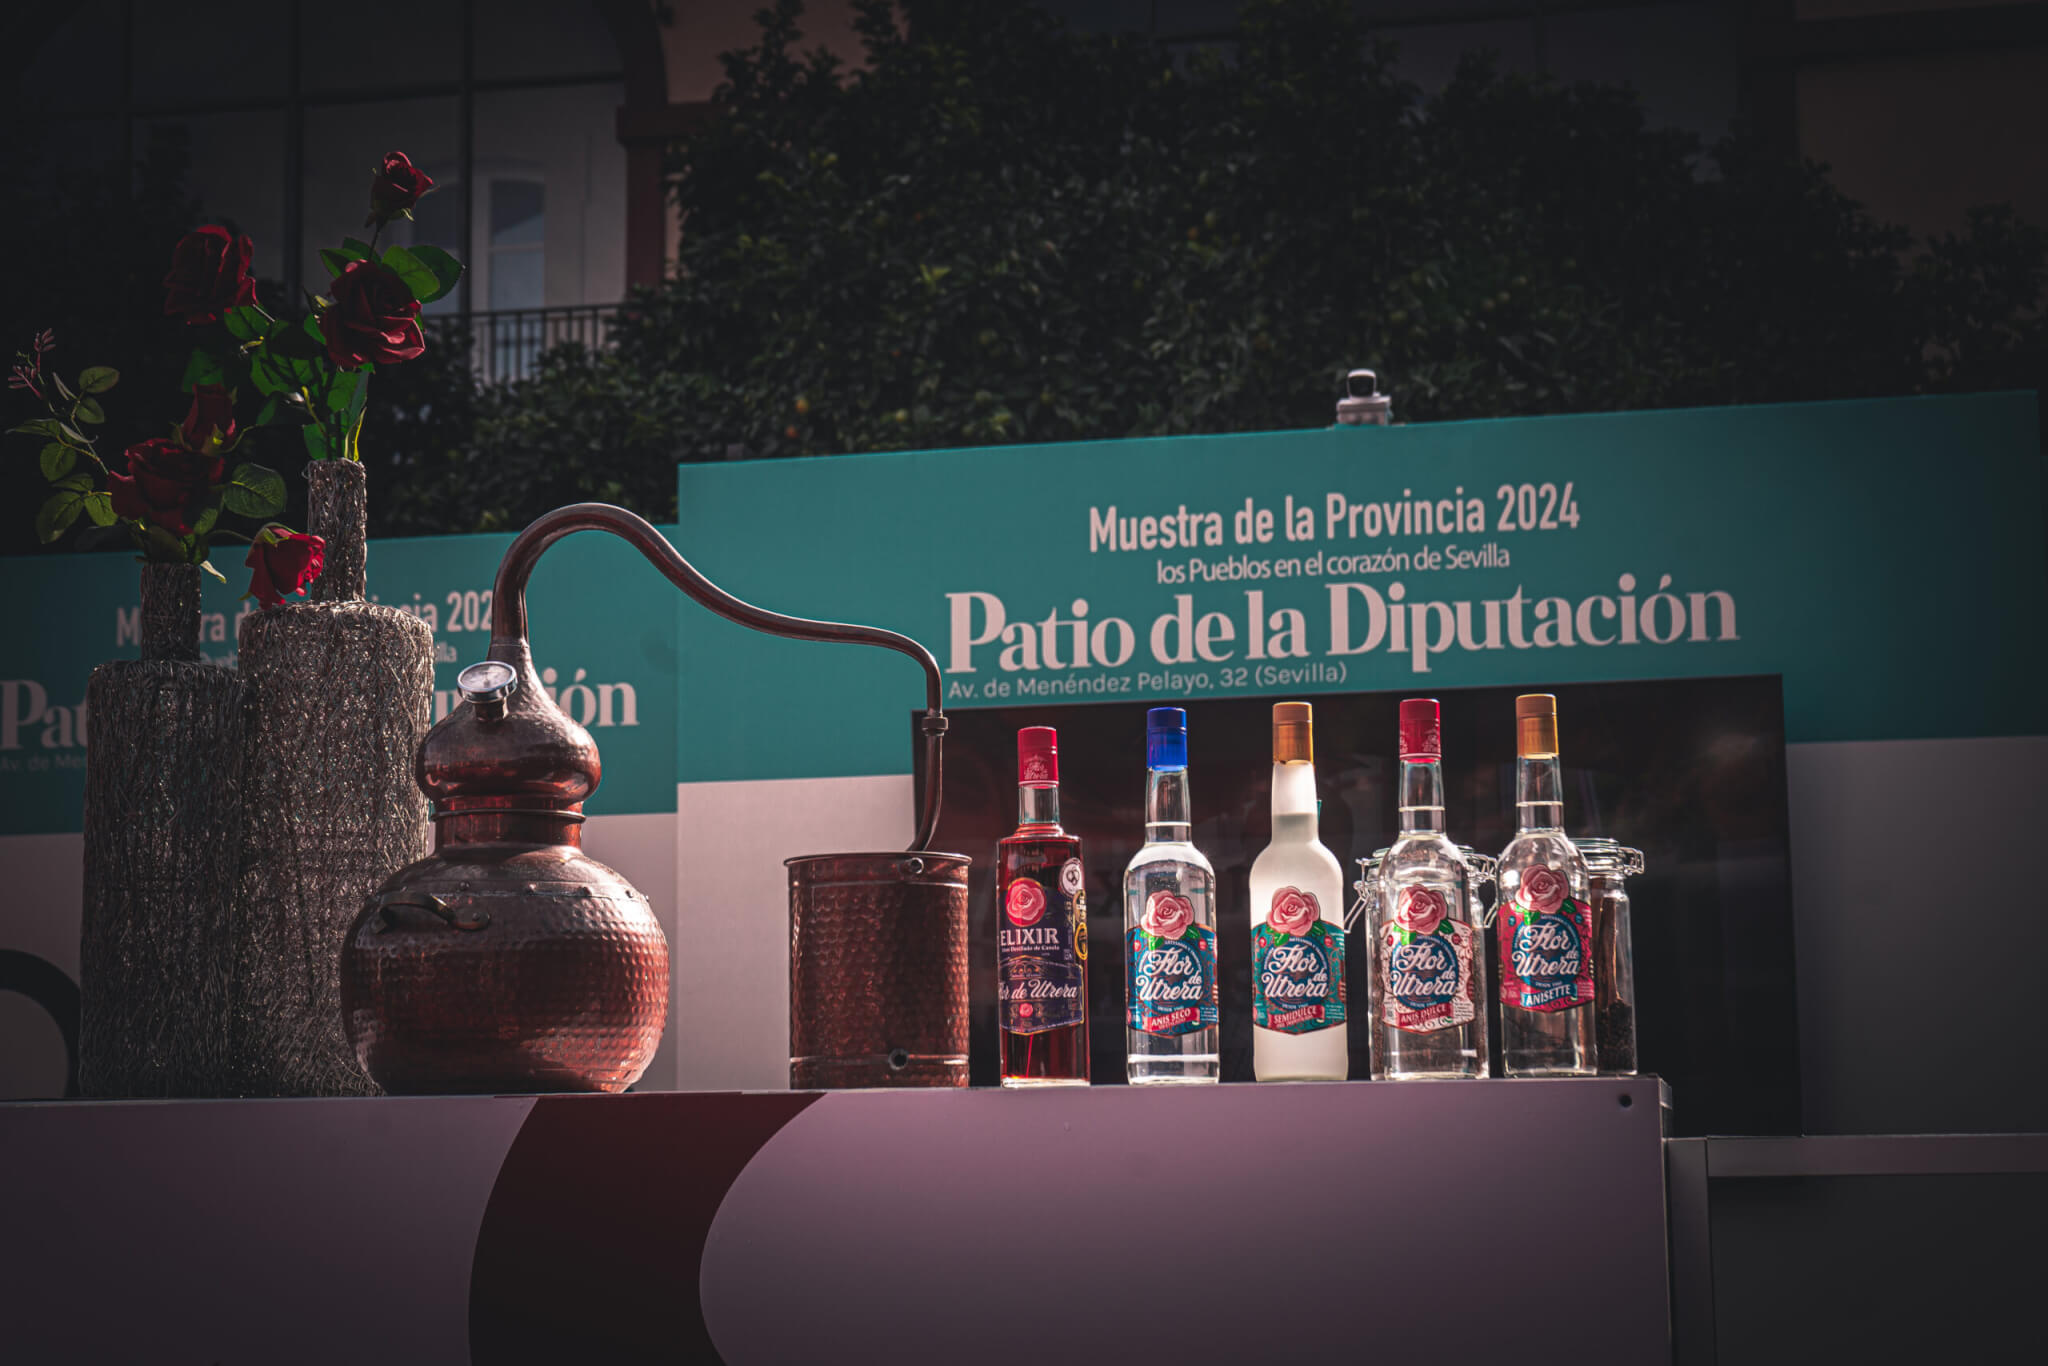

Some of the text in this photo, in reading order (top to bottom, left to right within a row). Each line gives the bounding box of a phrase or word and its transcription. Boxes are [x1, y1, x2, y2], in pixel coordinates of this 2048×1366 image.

[1089, 482, 1581, 552] Muestra de la Provincia 2024
[1157, 543, 1510, 584] los Pueblos en el corazón de Sevilla
[447, 590, 494, 632] 202
[945, 573, 1741, 674] Patio de la Diputación
[948, 661, 1347, 699] Av. de Menéndez Pelayo, 32 (Sevilla)
[1000, 928, 1059, 946] ELIXIR
[1519, 922, 1571, 951] Flor
[1144, 947, 1195, 975] Flor
[1269, 944, 1319, 973] Flor
[1395, 942, 1447, 971] Flor
[1511, 950, 1579, 976] Utrera
[1566, 945, 1578, 960] de
[1188, 970, 1202, 985] de
[1261, 972, 1329, 997] Utrera
[1313, 967, 1328, 982] de
[1390, 970, 1456, 996] Utrera
[1441, 966, 1456, 980] de
[1011, 982, 1028, 999] de
[1028, 979, 1077, 998] Utrera
[1136, 975, 1203, 1001] Utrera
[1526, 984, 1571, 1006] ANISETTE
[1171, 1008, 1192, 1021] SECO
[1274, 1005, 1317, 1023] SEMIDULCE
[1421, 1004, 1446, 1018] DULCE
